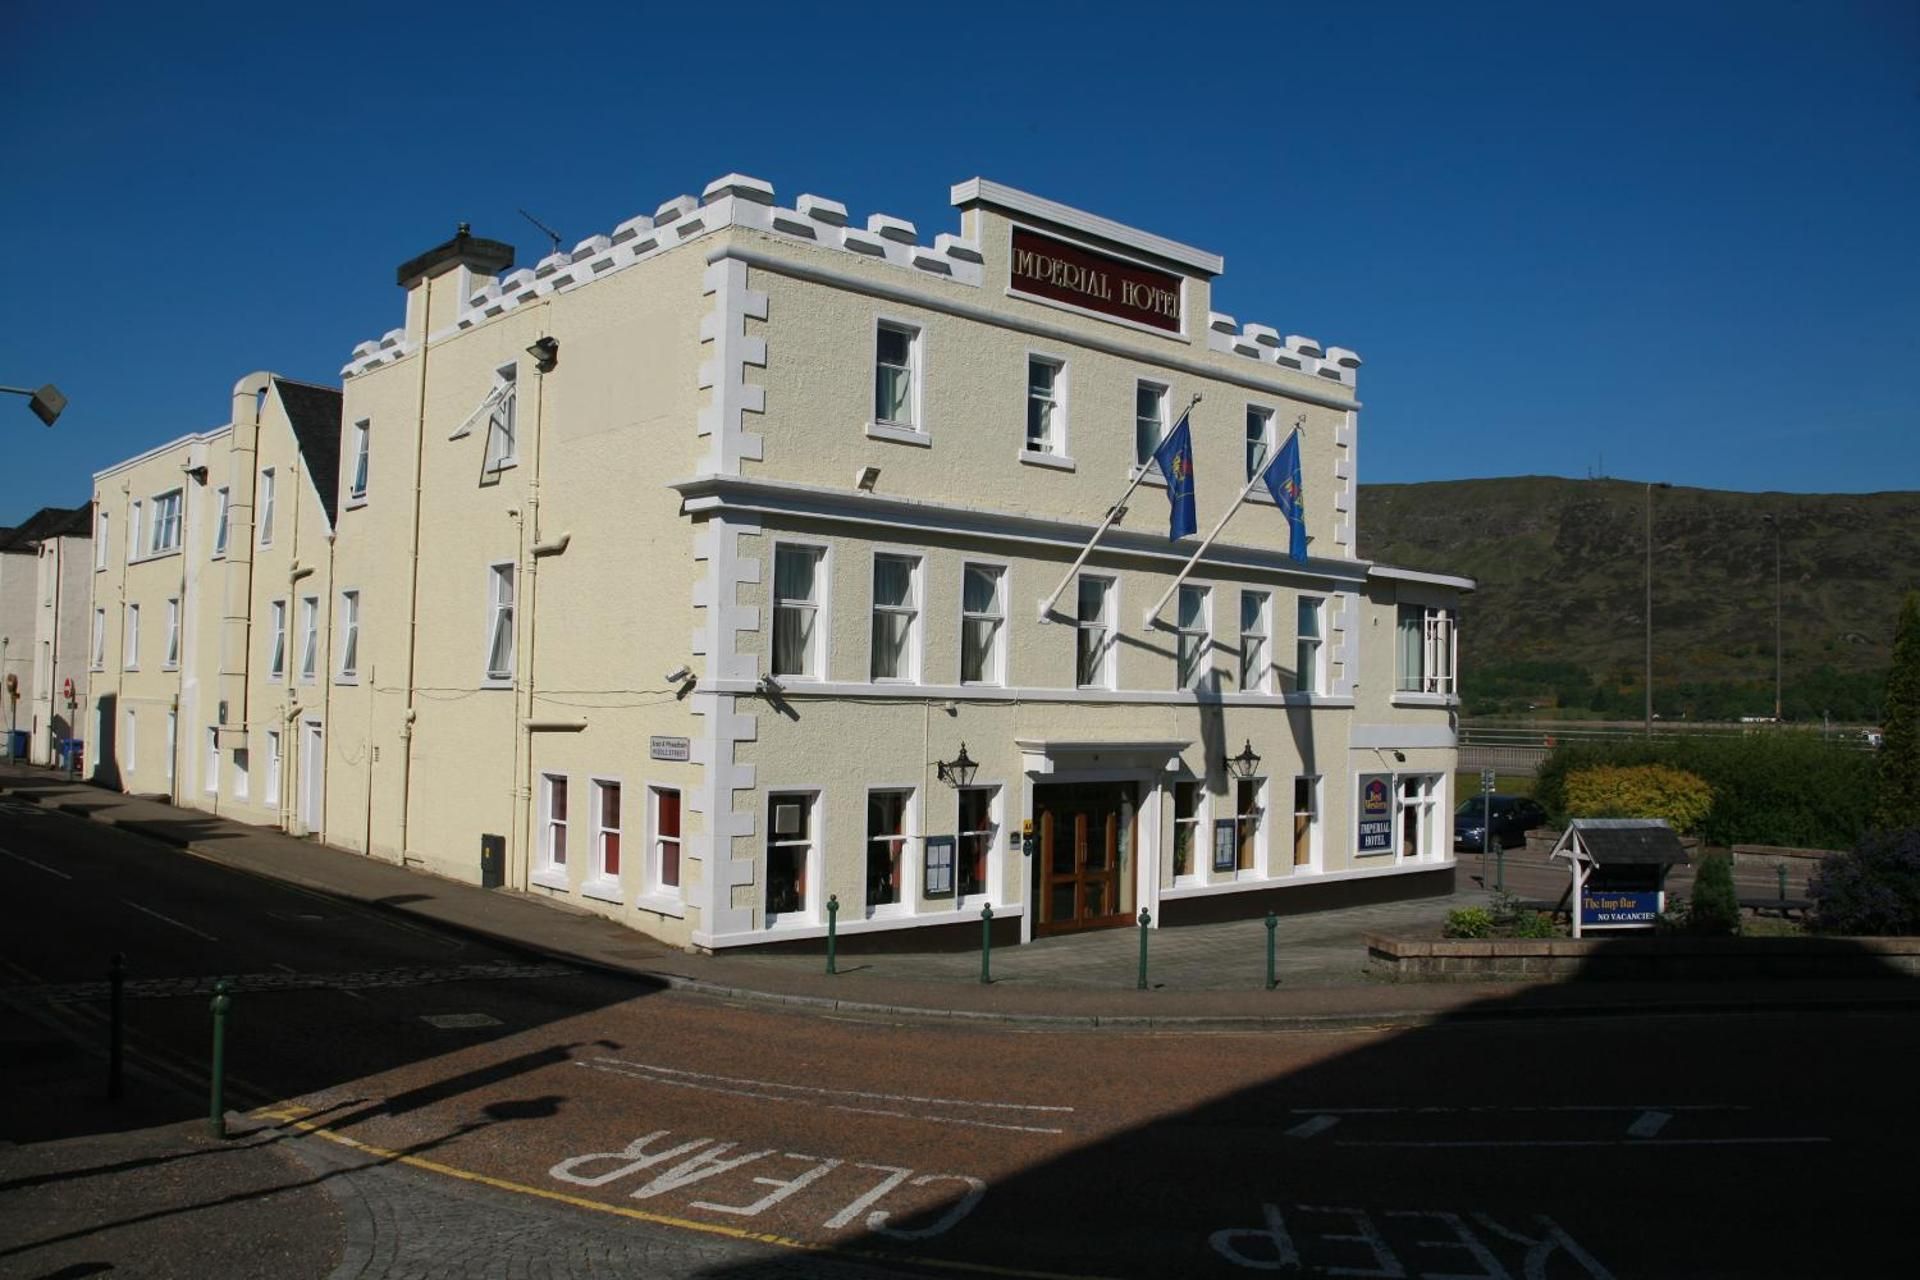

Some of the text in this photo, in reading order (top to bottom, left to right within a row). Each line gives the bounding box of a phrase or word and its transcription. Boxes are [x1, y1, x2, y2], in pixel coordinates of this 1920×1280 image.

[1121, 279, 1180, 319] HOTEL
[1361, 822, 1390, 834] IMPERIAL
[1365, 835, 1385, 846] HOTEL
[1584, 897, 1636, 910] The Imp Bar
[1611, 912, 1656, 920] VACANCIES
[548, 1130, 1618, 1279] KEEP CLEAR
